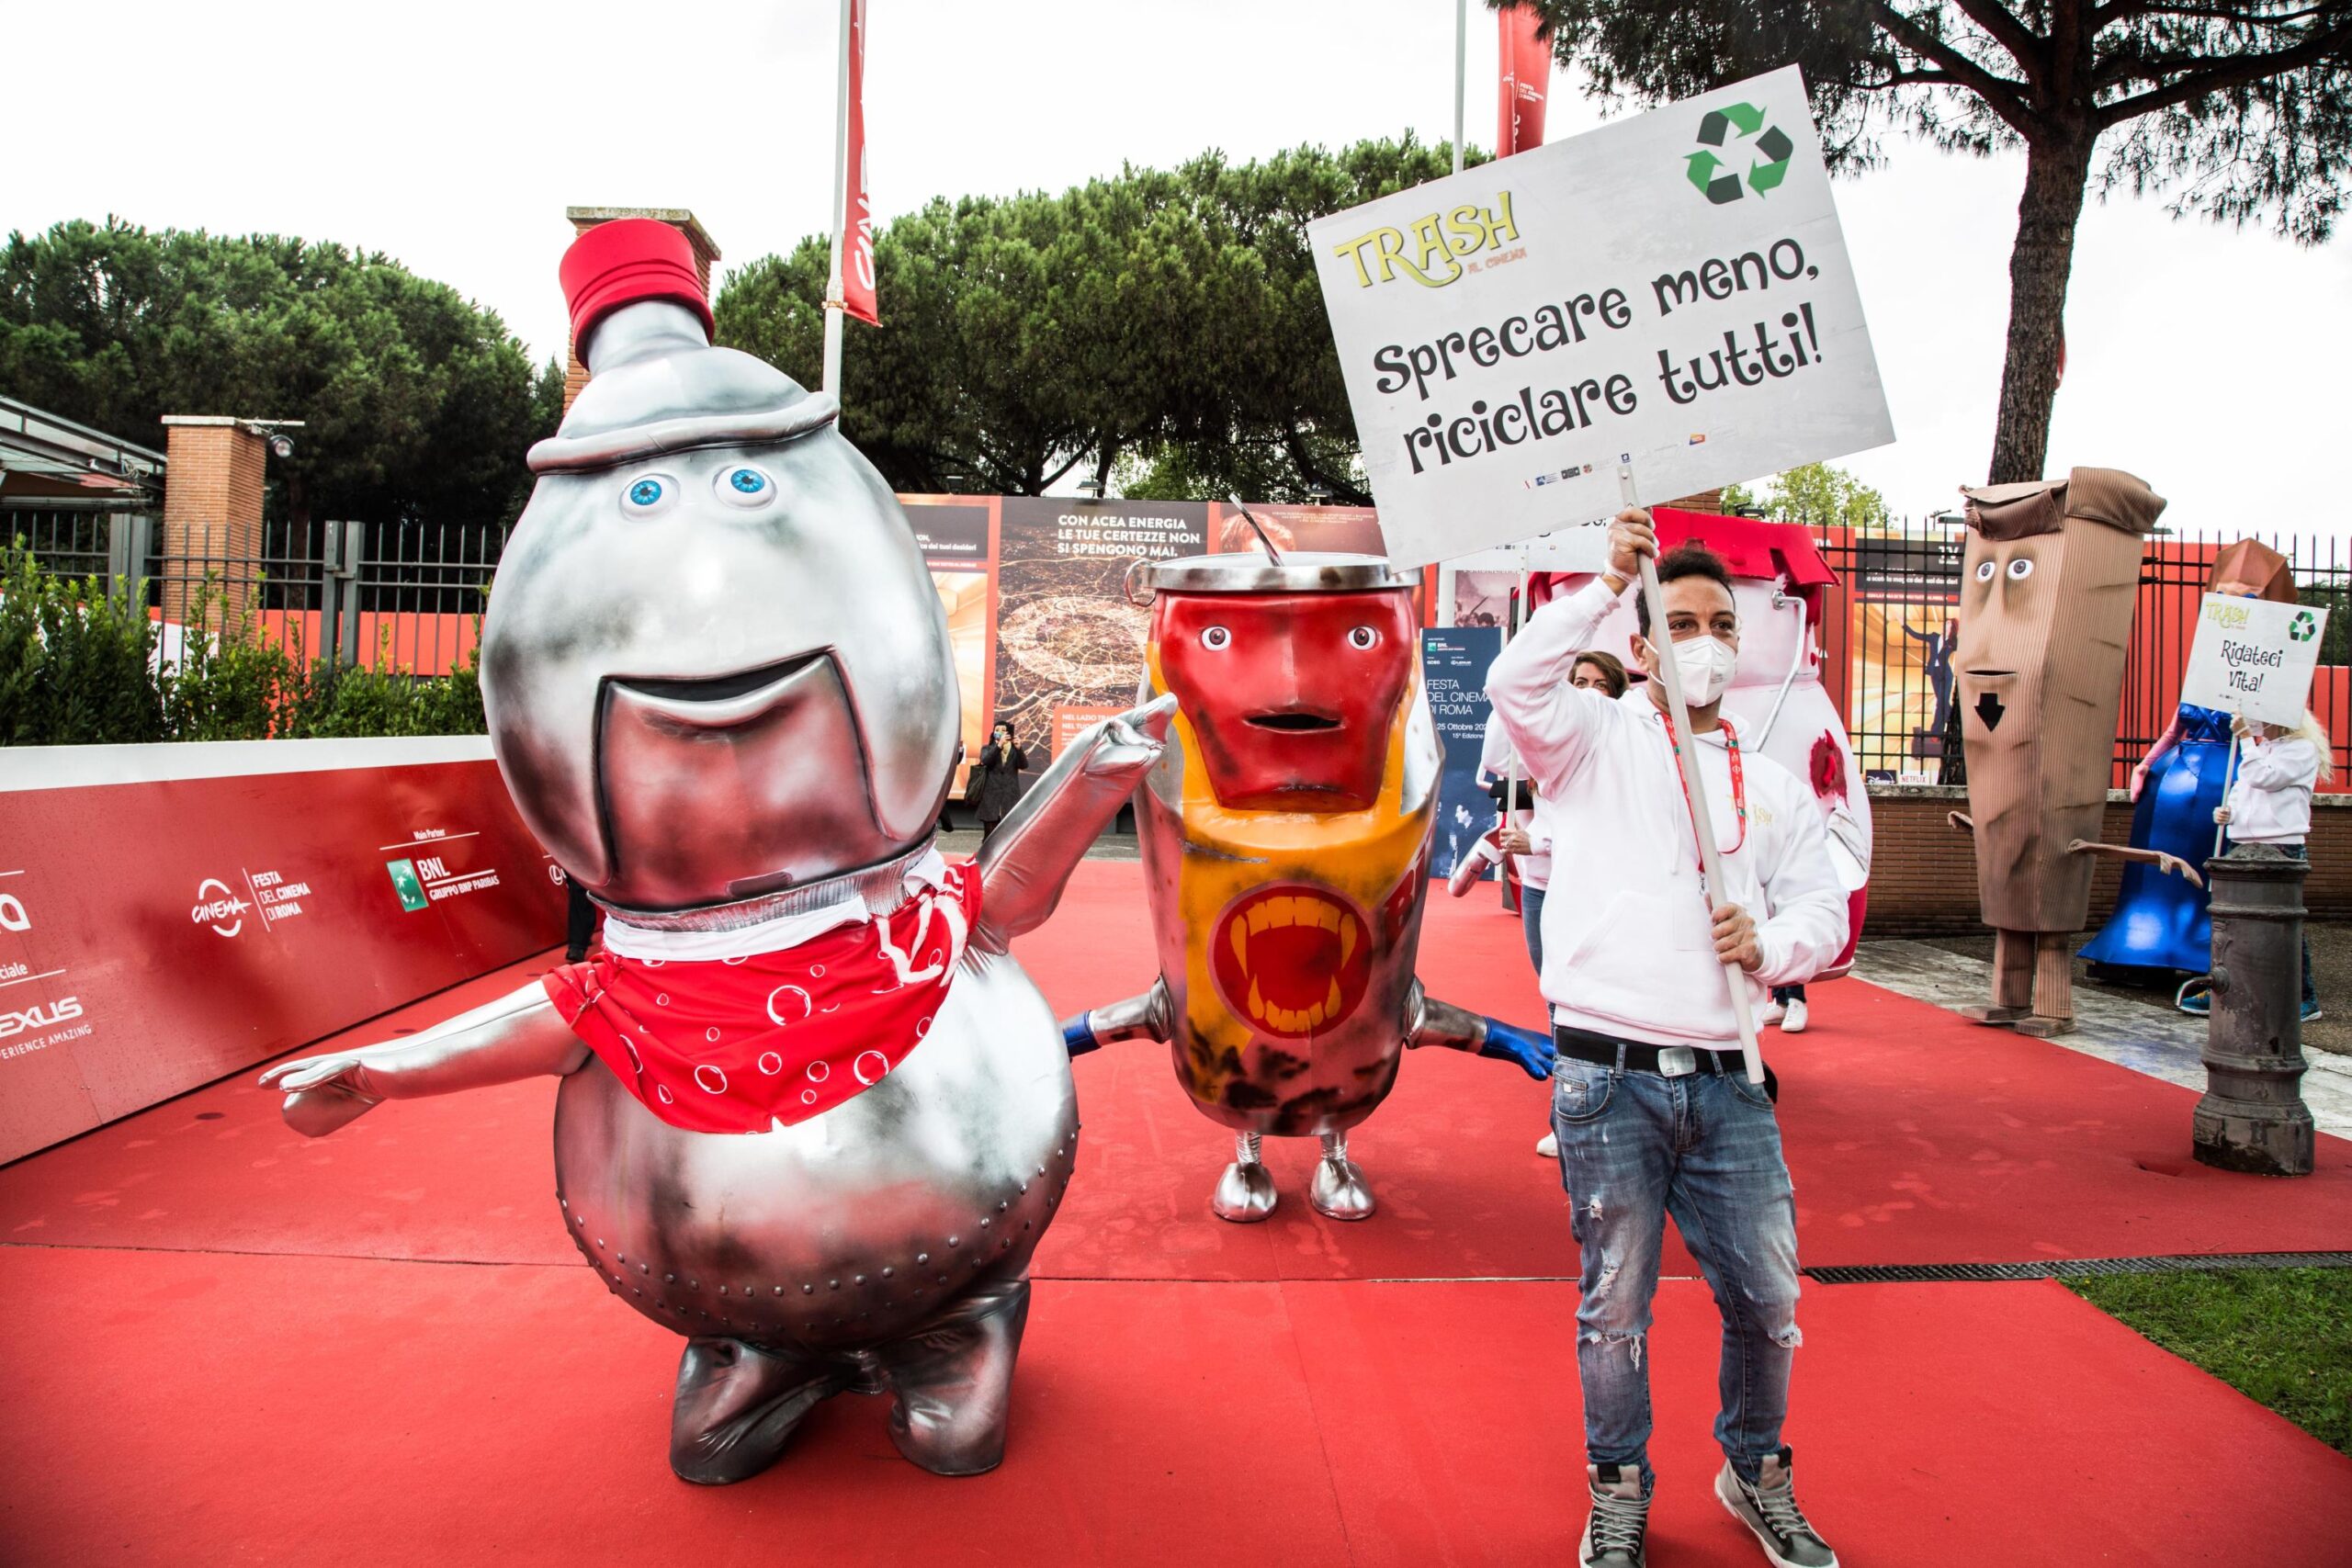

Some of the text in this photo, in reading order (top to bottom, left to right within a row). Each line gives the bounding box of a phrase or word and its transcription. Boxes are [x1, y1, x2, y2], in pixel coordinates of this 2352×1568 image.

[1333, 190, 1520, 288] TRASH
[1485, 247, 1528, 269] CINEMA
[1374, 237, 1820, 401] Sprecare meno,
[1403, 301, 1824, 475] riciclare tutti!
[1057, 514, 1187, 530] CON ACEA ENERGIA
[1057, 529, 1201, 544] LE TUE CERTEZZE NON
[1057, 542, 1179, 558] SI SPENGONO MAI.
[2221, 639, 2284, 669] Ridateci
[1426, 679, 1460, 690] FESTA
[2229, 671, 2265, 694] Vita!
[1439, 705, 1474, 715] ROMA
[1436, 723, 1446, 731] 25
[1447, 723, 1474, 731] Ottobre
[1901, 775, 1927, 784] NETFLIX
[251, 871, 283, 888] FESTA
[416, 856, 451, 882] BNL
[258, 882, 312, 905] DEL CINEMA
[429, 874, 501, 901] GRUPPO BNP PARIBAS
[191, 896, 253, 924] CINEMA
[0, 962, 28, 980] ciale
[0, 996, 84, 1037] EXUS
[49, 1024, 92, 1046] AMAZING
